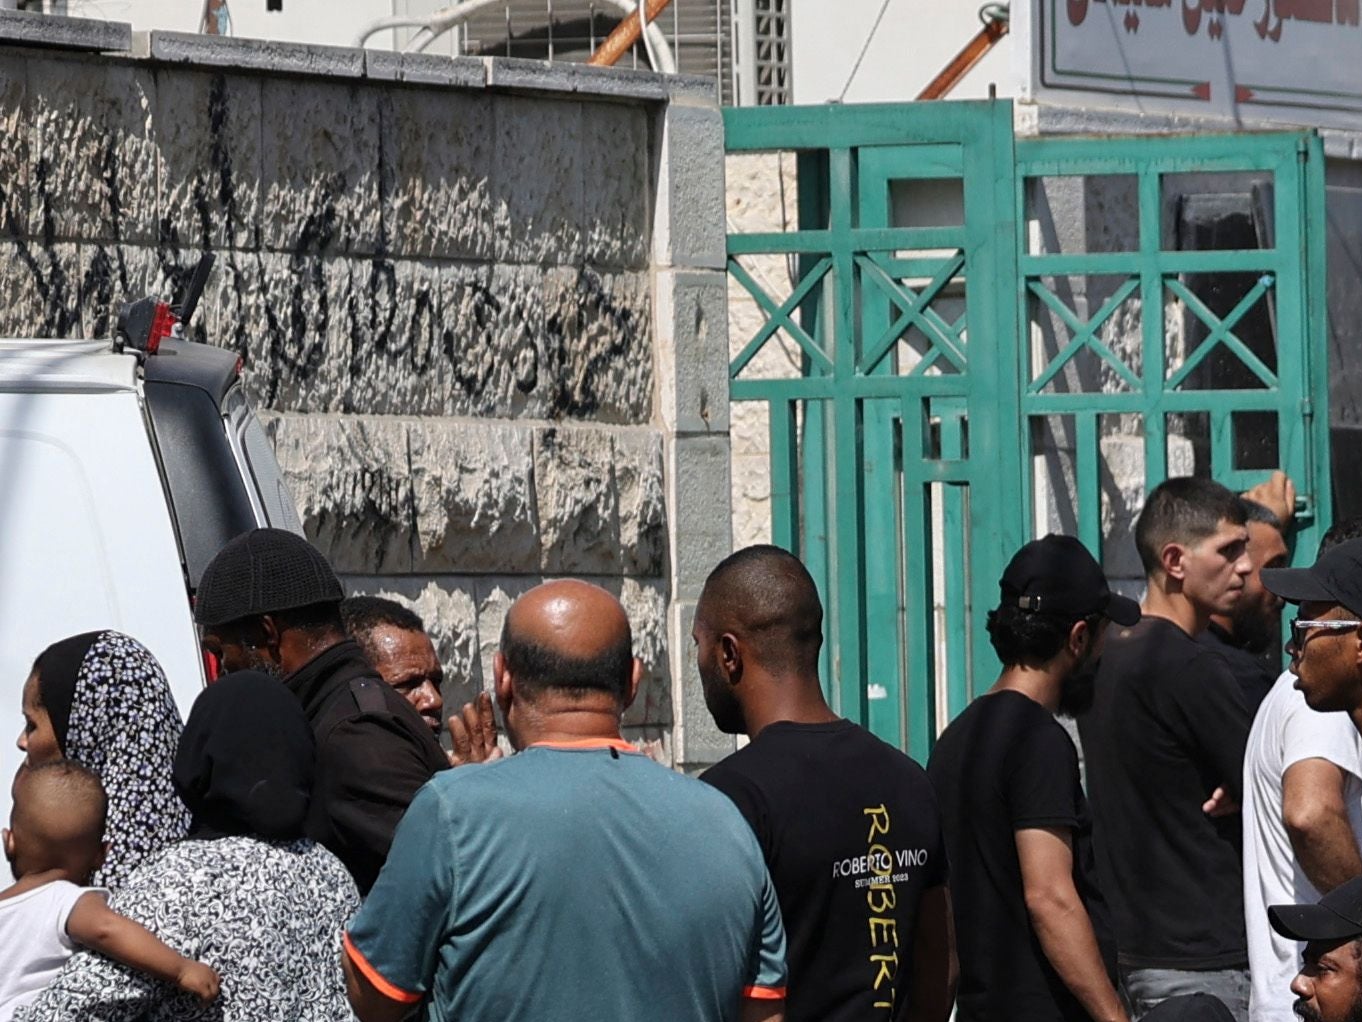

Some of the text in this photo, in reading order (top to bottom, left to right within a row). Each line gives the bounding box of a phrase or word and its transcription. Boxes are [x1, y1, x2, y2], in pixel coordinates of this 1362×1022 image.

[832, 848, 928, 878] ROBERTO VINO
[854, 874, 891, 888] SUMMER
